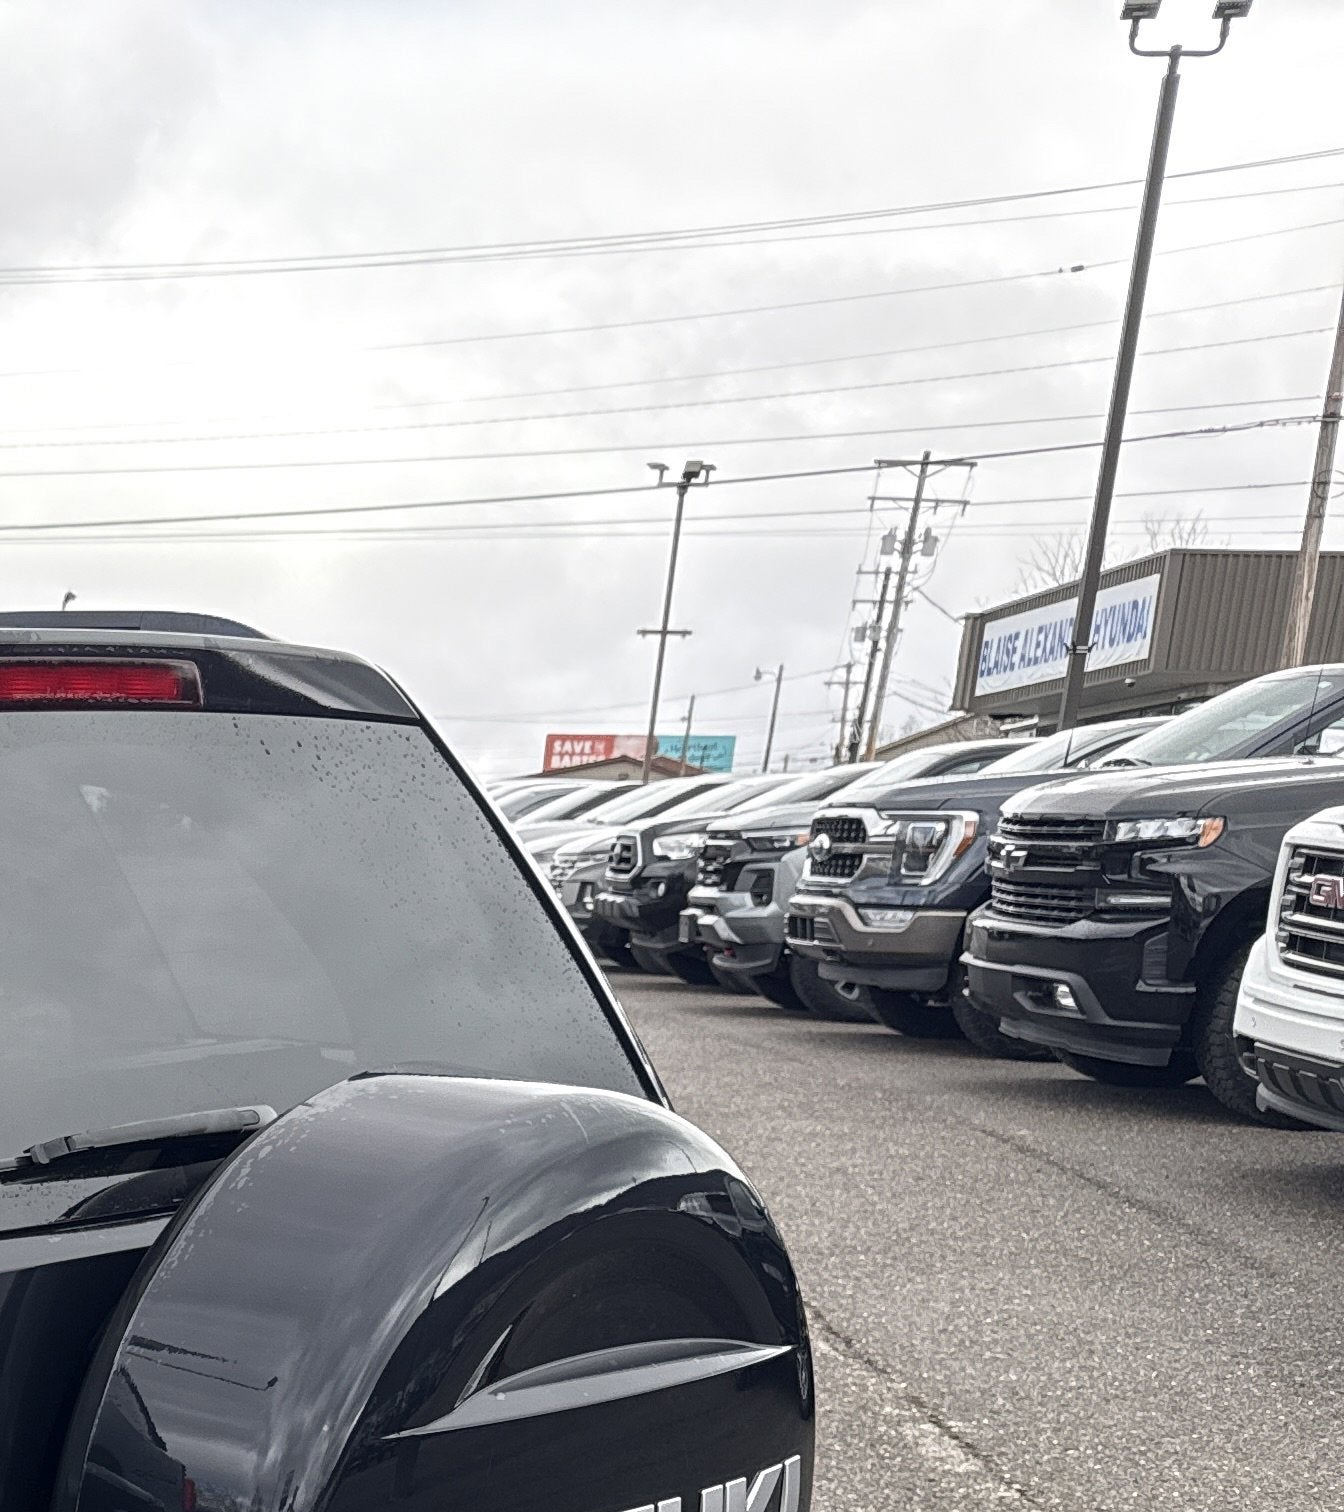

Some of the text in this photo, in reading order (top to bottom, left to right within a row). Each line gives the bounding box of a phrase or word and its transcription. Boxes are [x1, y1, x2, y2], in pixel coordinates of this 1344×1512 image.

[980, 595, 1153, 678] BLAISE ALEXAND HYUNDAI
[552, 740, 592, 754] SAVE
[1309, 877, 1344, 910] GM
